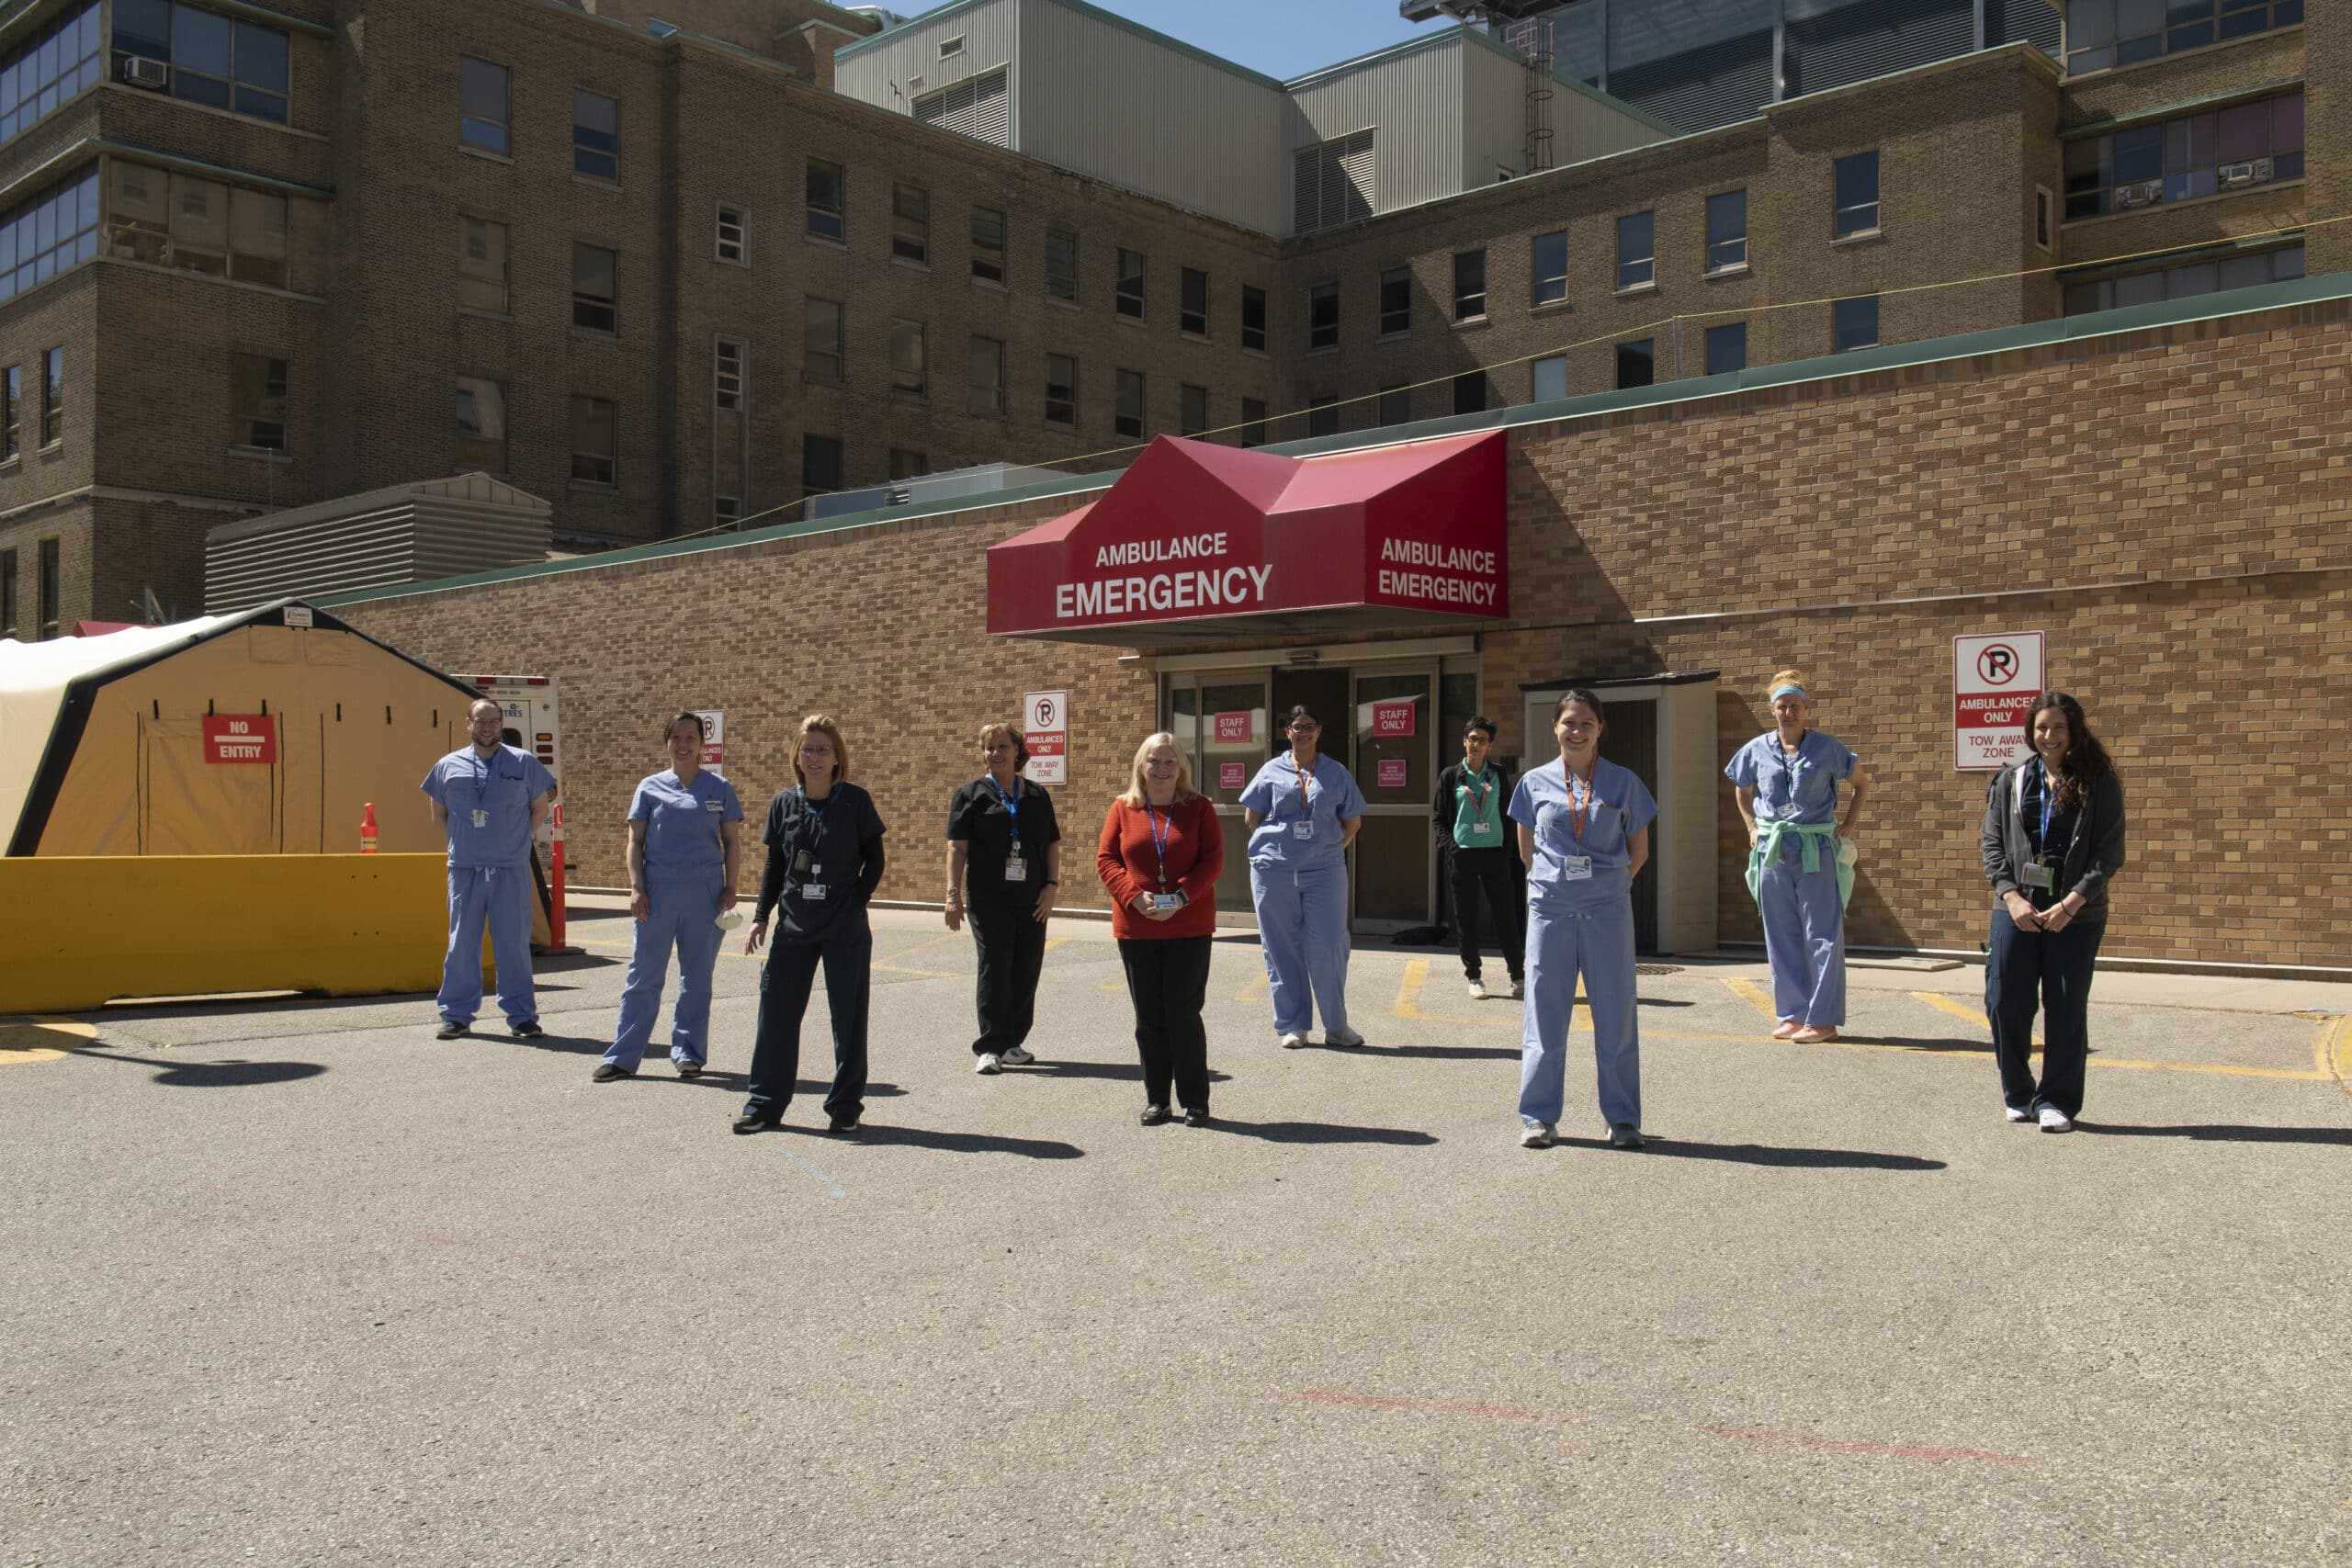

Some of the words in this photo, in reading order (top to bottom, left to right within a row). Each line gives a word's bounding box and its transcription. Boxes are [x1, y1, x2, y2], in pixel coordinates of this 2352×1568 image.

[1096, 532, 1227, 568] AMBULANCE
[1381, 537, 1496, 574] AMBULANCE
[1057, 564, 1273, 617] EMERGENCY
[1379, 569, 1497, 605] EMERGENCY
[1379, 710, 1408, 719] STAFF
[1984, 712, 2012, 723] ONLY
[230, 721, 249, 734] NO
[1220, 718, 1244, 728] STAFF
[1382, 720, 1406, 729] ONLY
[1221, 728, 1243, 737] ONLY
[1026, 736, 1064, 744] AMBULANCES
[1969, 736, 1994, 746] TOW
[220, 745, 262, 758] ENTRY
[1983, 748, 2014, 758] ZONE
